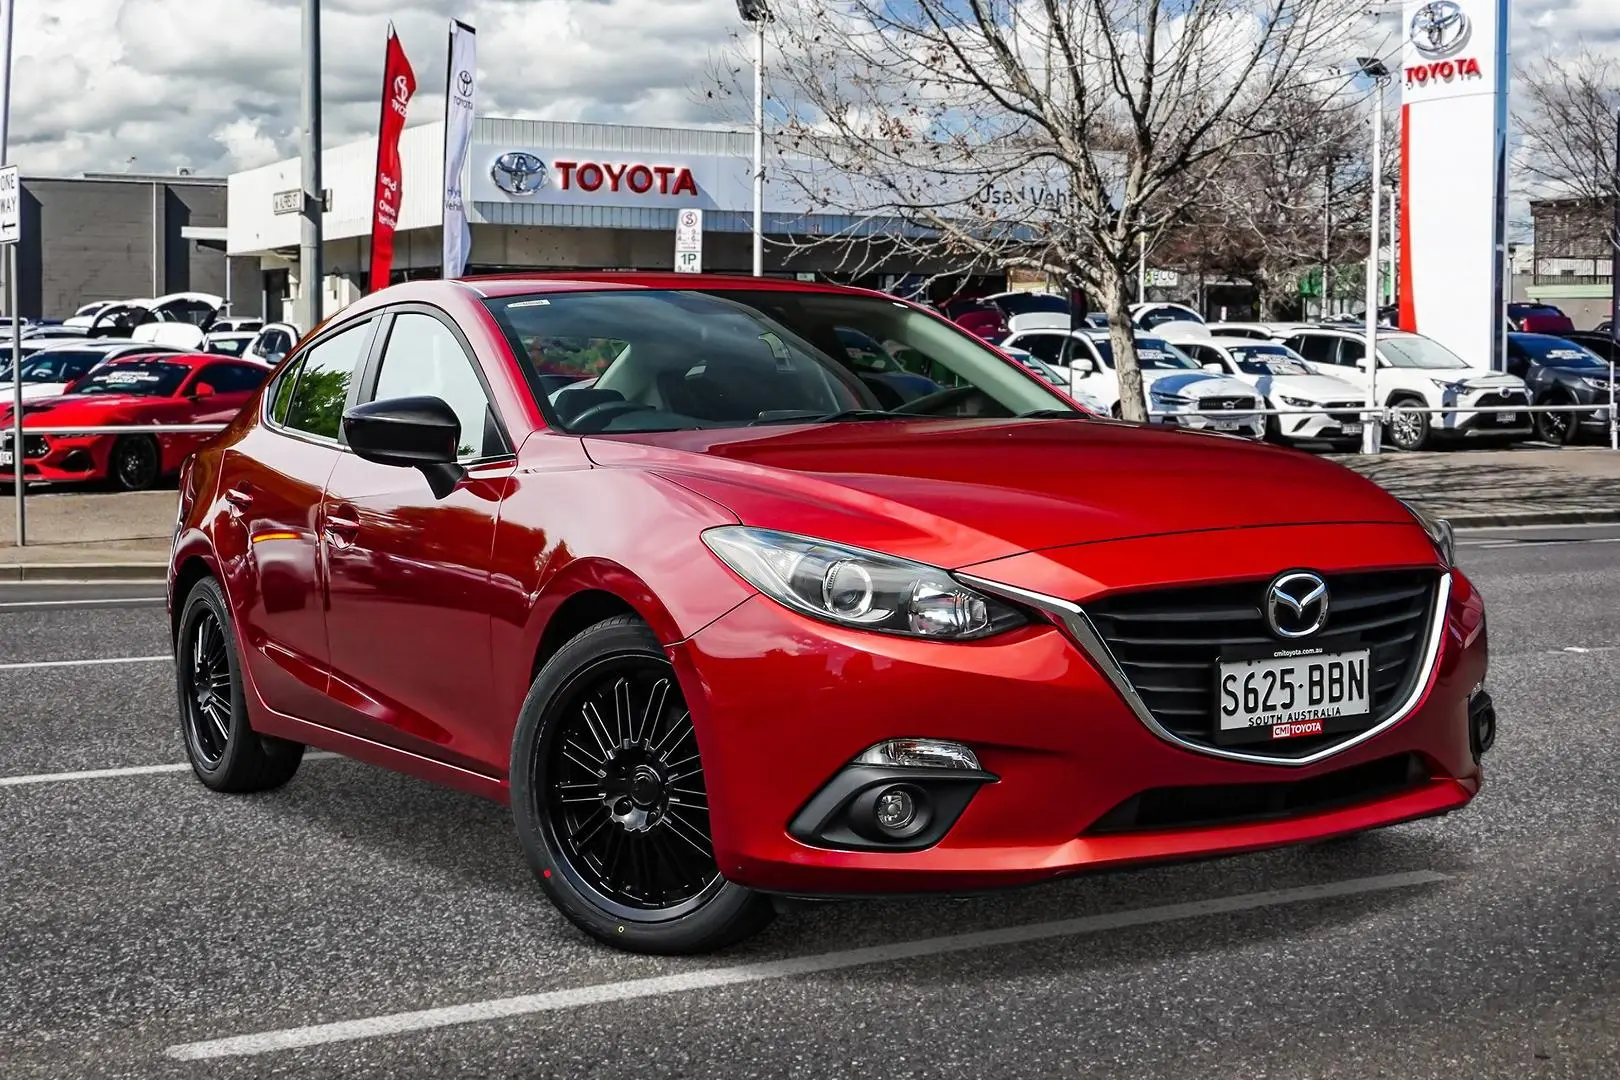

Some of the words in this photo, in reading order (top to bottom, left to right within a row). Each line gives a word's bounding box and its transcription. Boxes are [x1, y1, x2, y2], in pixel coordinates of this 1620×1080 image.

[1404, 58, 1480, 83] TOYOTA
[0, 173, 15, 191] ONE
[555, 161, 698, 196] TOYOTA
[0, 196, 16, 214] WAY
[680, 253, 697, 265] 1P
[1273, 647, 1323, 658] cmitoyota.com.au
[1248, 713, 1283, 727] SOUTH
[1287, 707, 1341, 722] AUSTRALIA
[1274, 725, 1290, 737] CMI
[1290, 722, 1322, 735] TOYOTA
